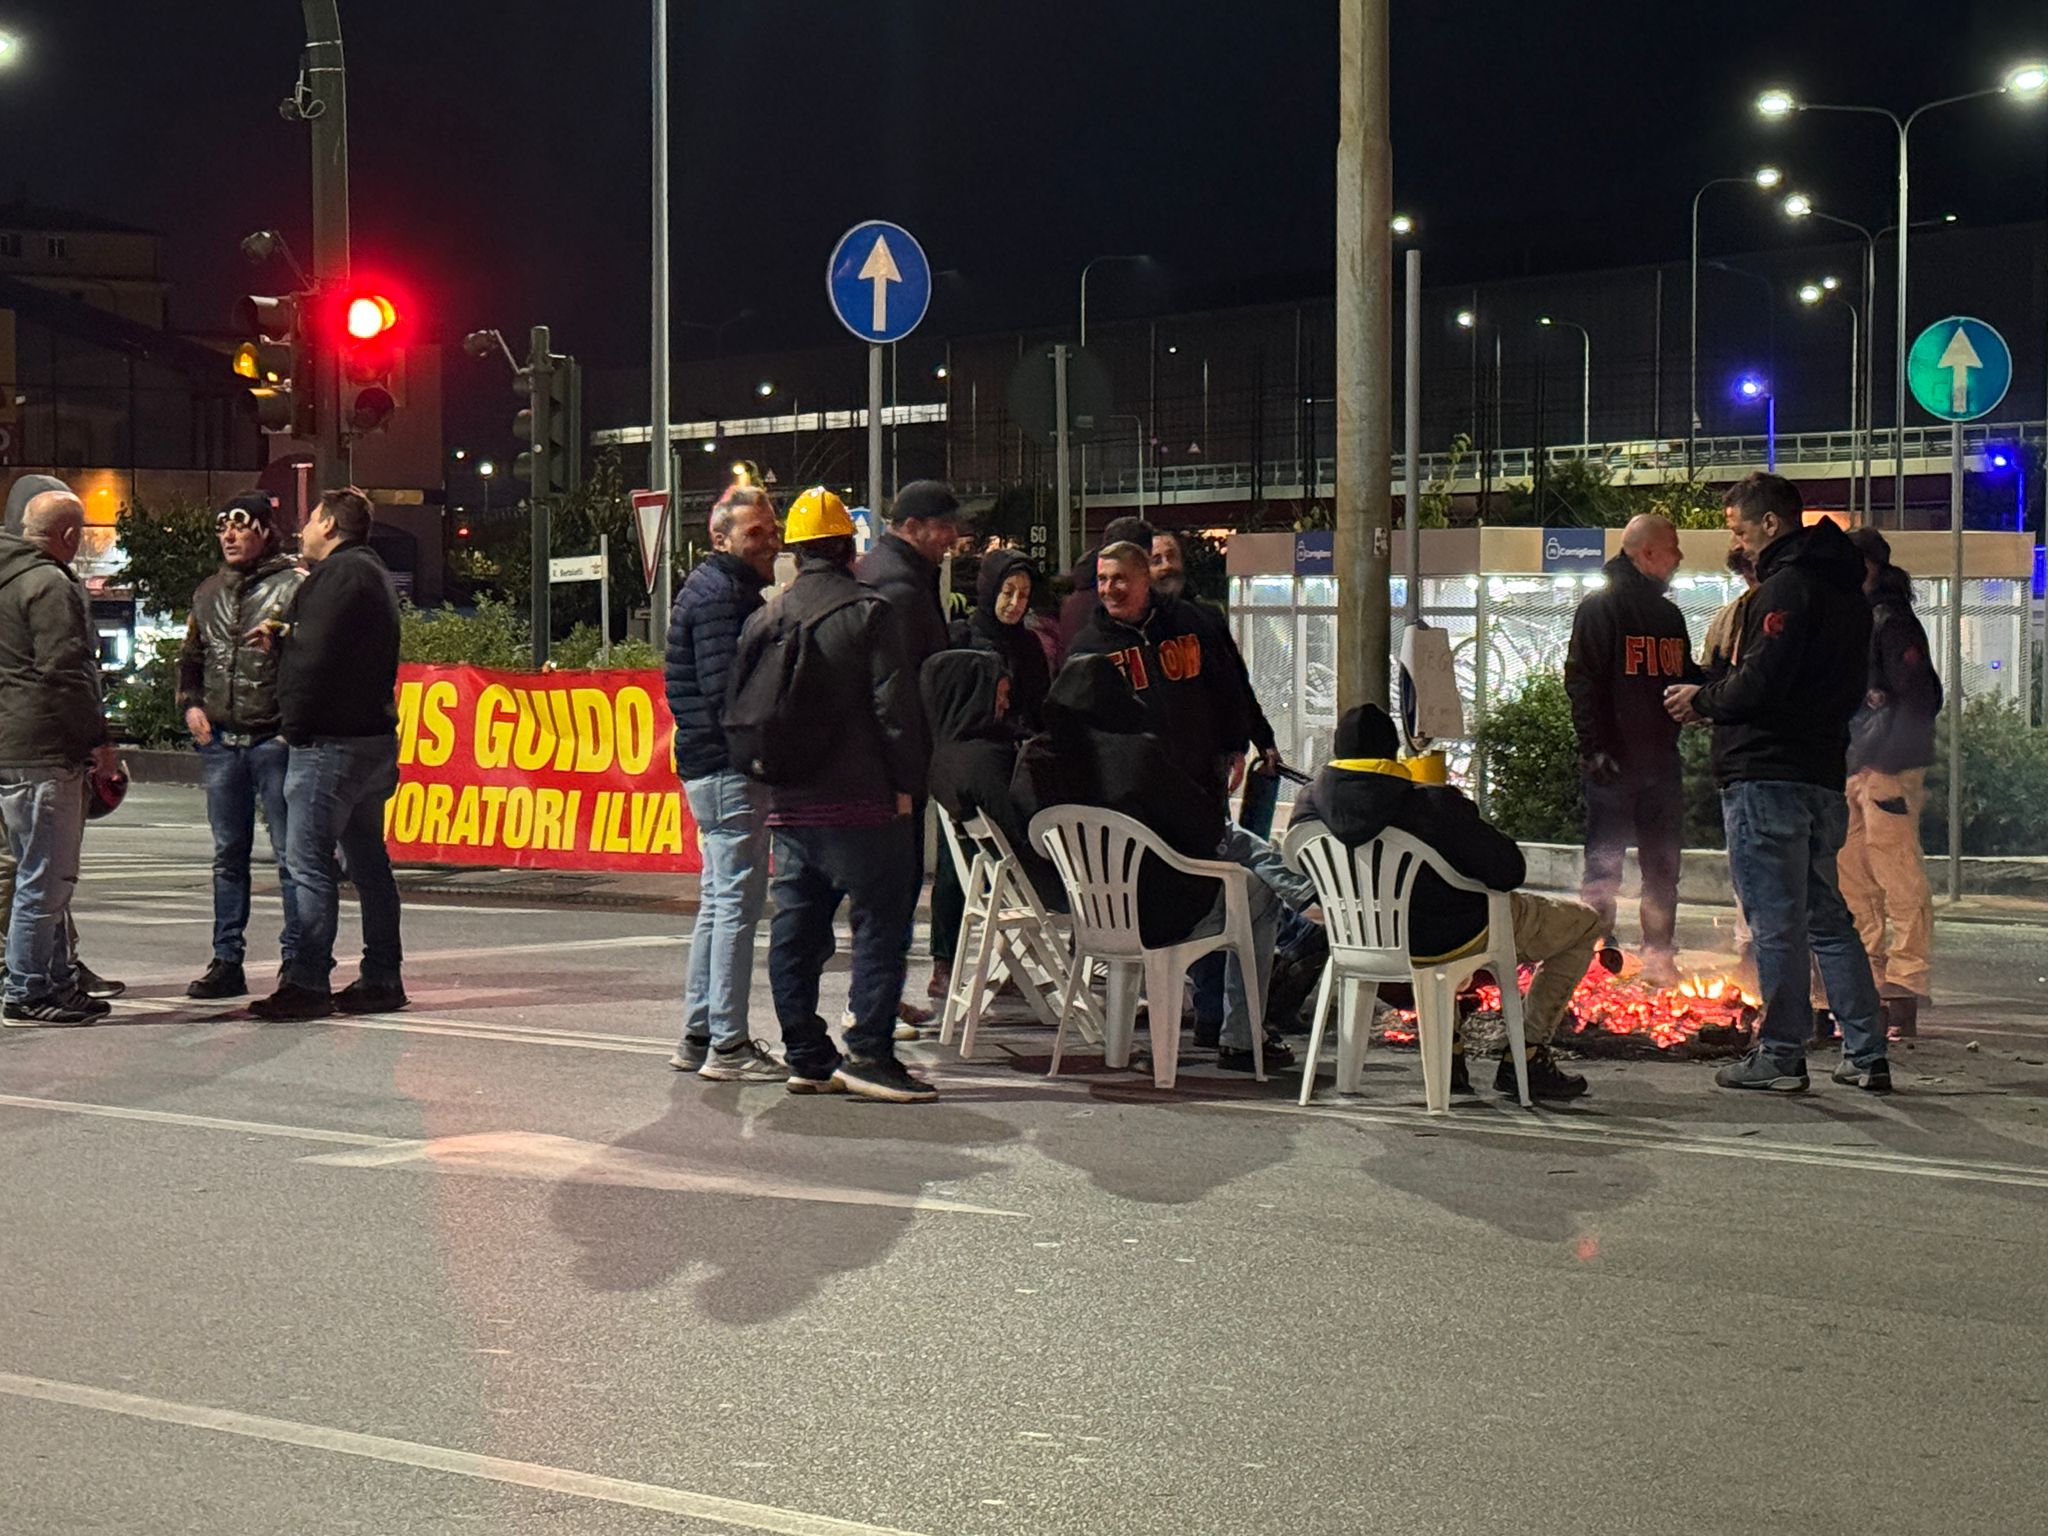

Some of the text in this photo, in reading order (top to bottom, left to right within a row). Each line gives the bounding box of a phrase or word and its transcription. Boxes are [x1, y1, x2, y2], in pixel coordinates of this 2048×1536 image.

[1030, 526, 1046, 543] 60
[474, 683, 654, 775] GUIDO
[589, 791, 684, 855] ILVA
